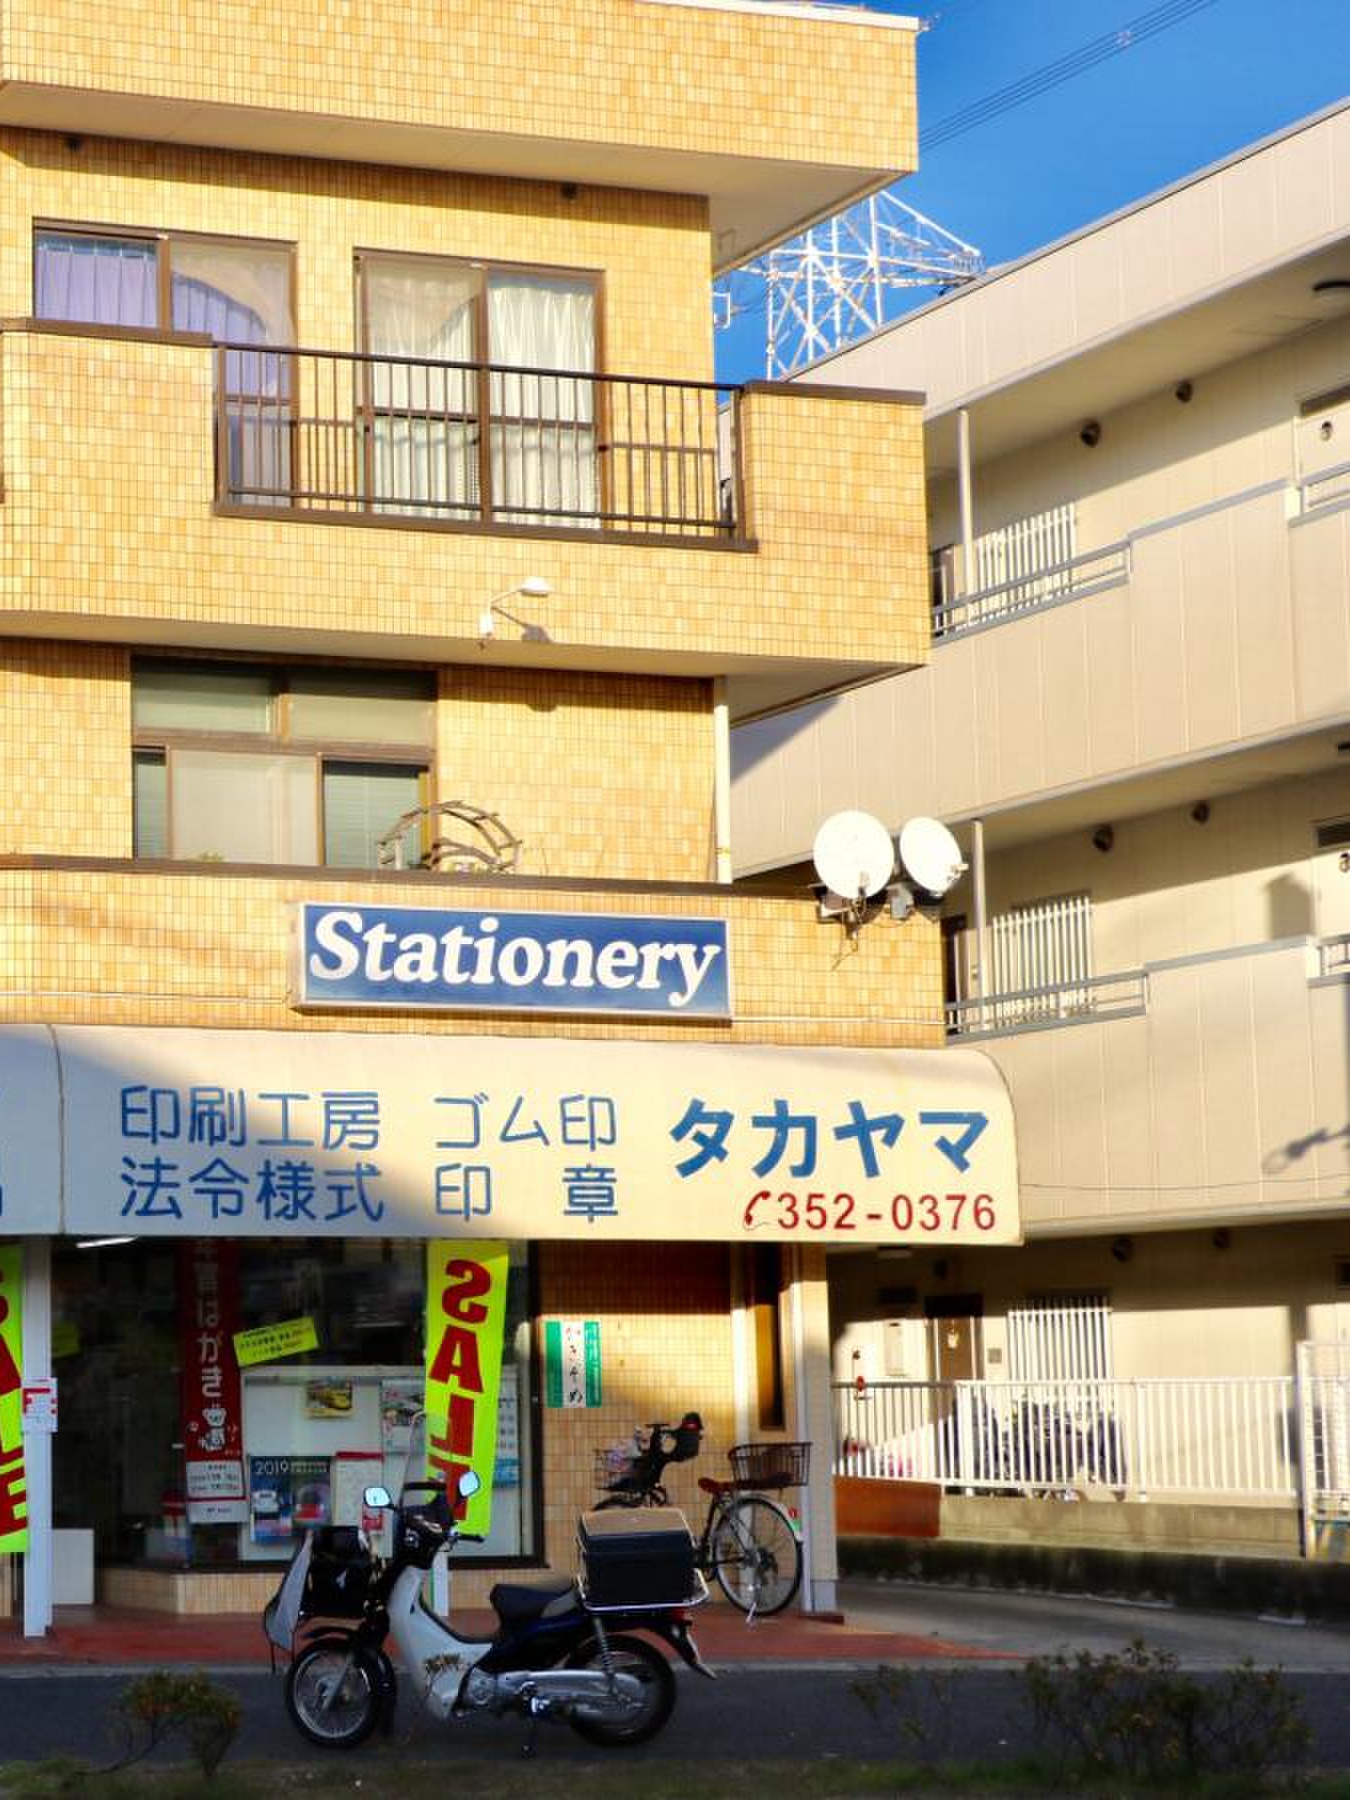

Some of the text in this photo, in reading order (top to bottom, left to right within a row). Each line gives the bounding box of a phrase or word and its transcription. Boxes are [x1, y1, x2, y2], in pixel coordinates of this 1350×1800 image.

[310, 911, 722, 1007] Stationery
[120, 1086, 617, 1150] 印刷工房 ゴム印
[670, 1098, 989, 1180] タカヤマ
[119, 1157, 385, 1223] 法令様式
[777, 1193, 997, 1232] 352-0376
[254, 1460, 289, 1476] 2019
